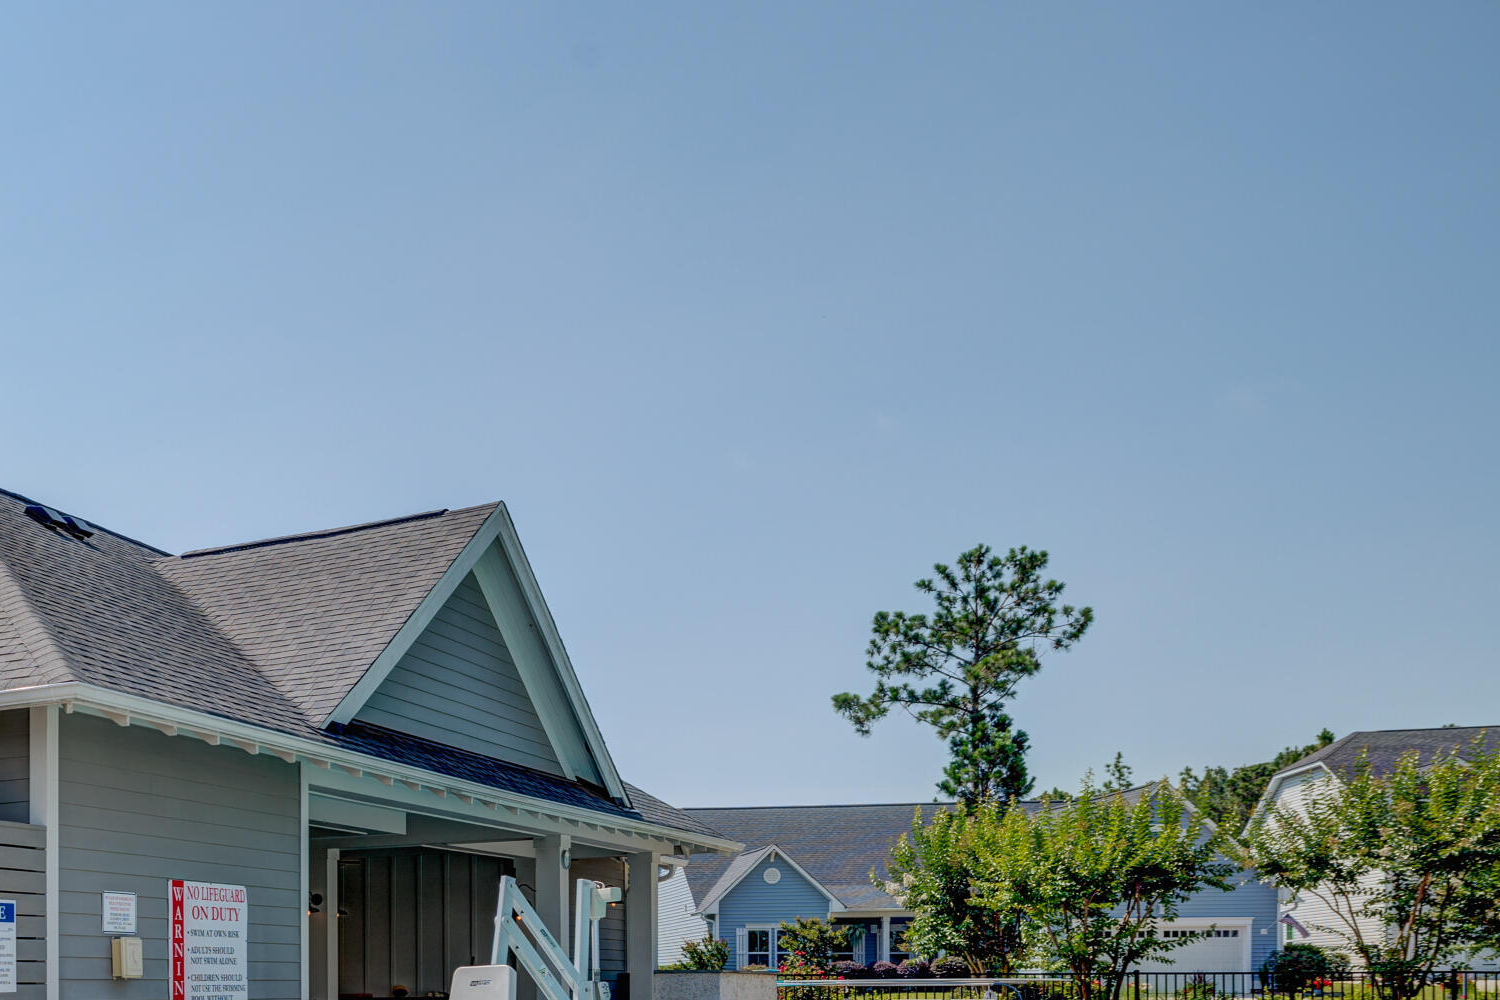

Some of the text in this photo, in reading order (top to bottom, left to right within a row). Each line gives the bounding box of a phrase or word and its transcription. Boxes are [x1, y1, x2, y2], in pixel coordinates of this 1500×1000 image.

[186, 885, 246, 903] NO LIFEGUARD
[191, 905, 241, 922] ON DUTY
[205, 929, 212, 937] AT
[227, 930, 240, 938] RISK
[190, 946, 235, 954] ADULTS SHOULD
[190, 957, 237, 965] NOT SWIM ALONE
[190, 973, 243, 982] CHILDREN SHOULD
[190, 984, 246, 992] NOT USE THE SWIMMING
